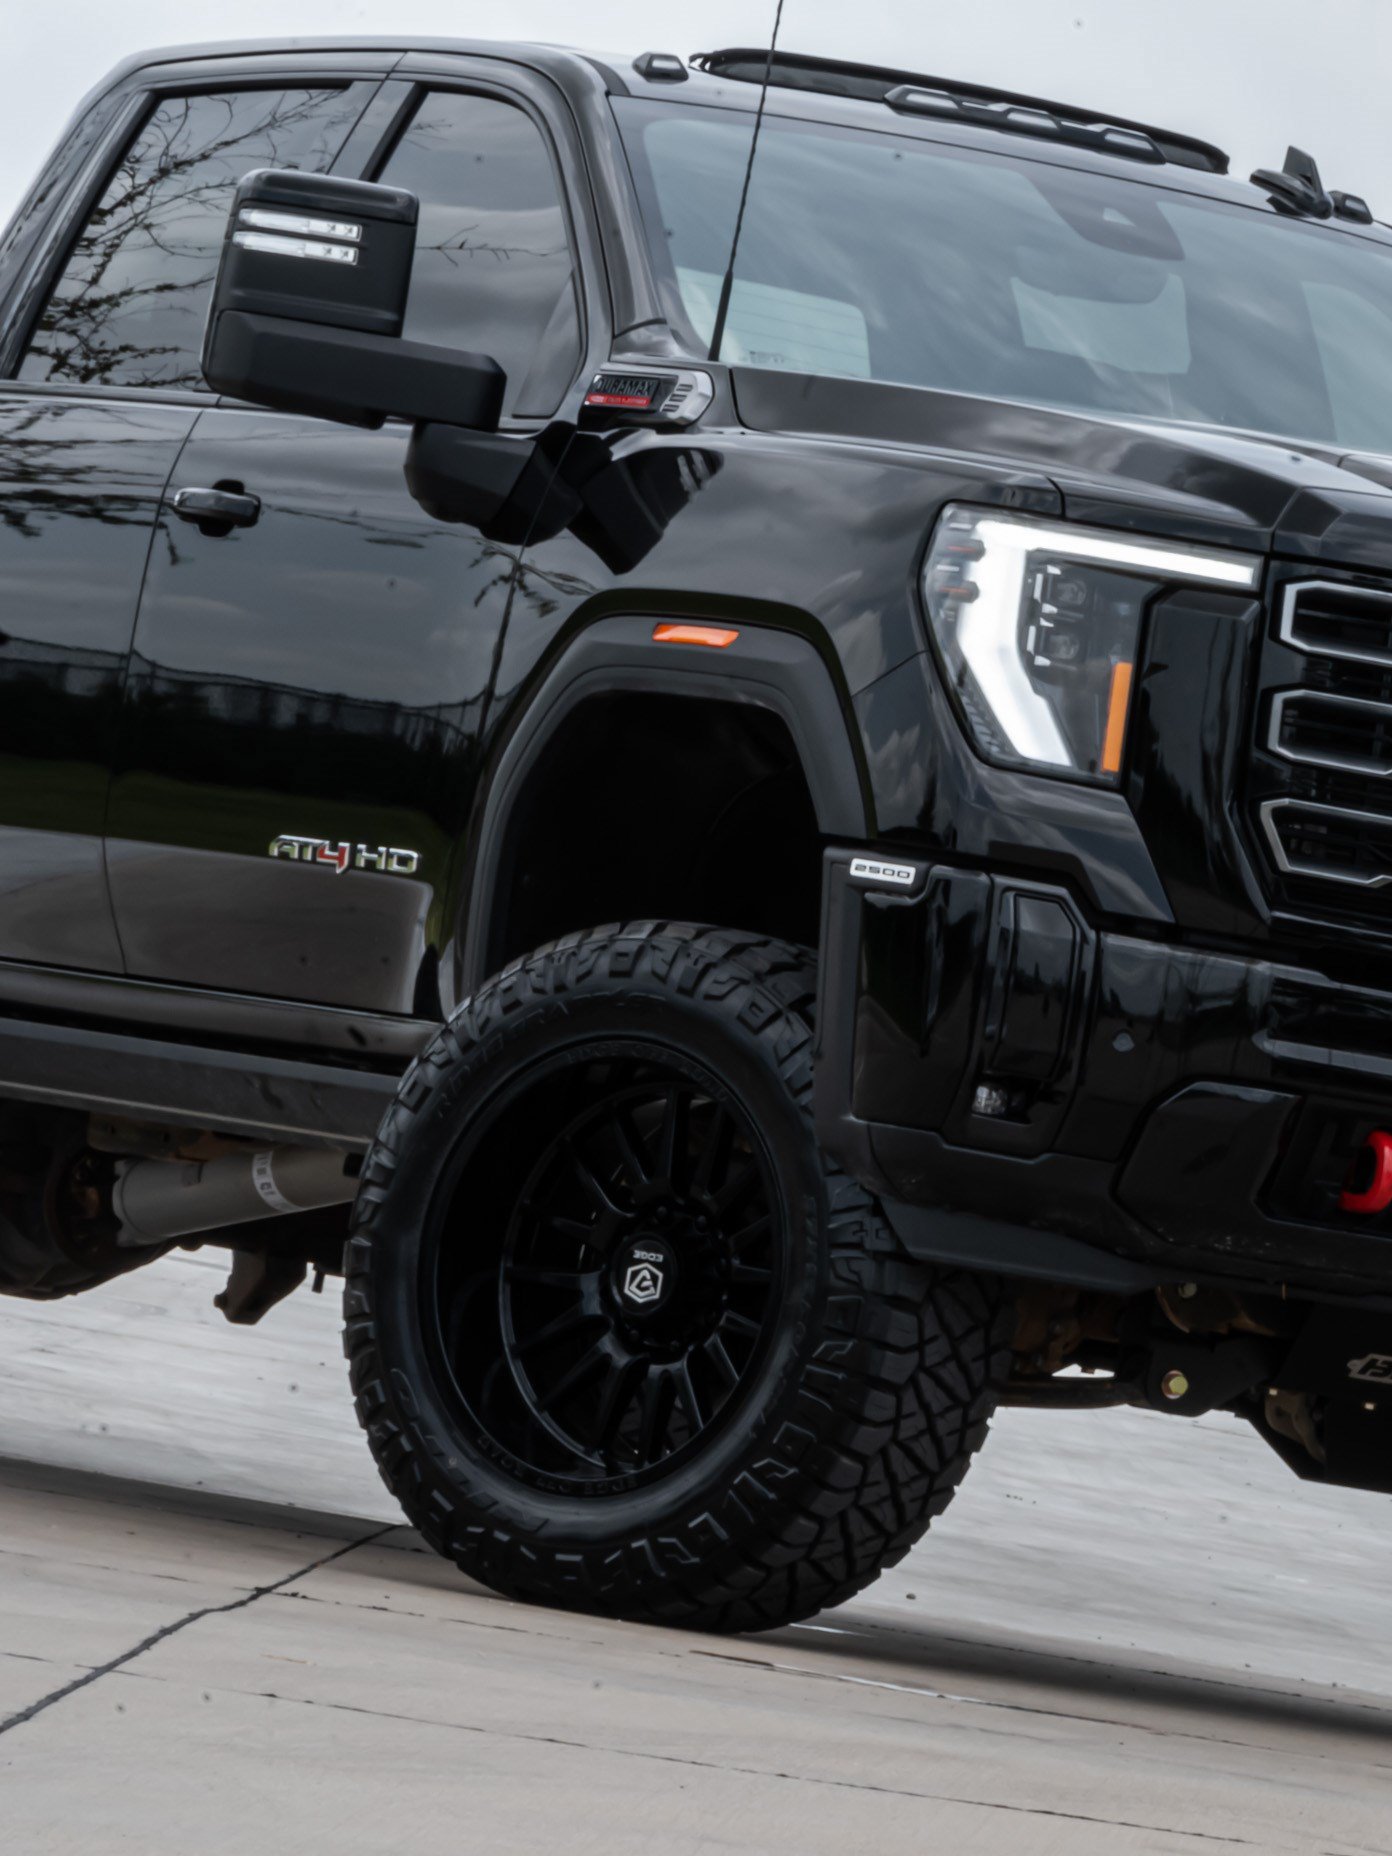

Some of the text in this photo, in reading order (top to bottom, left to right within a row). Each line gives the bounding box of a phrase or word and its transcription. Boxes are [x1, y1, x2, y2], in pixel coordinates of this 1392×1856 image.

[269, 834, 419, 874] AT4 HD
[854, 863, 911, 879] 2500
[633, 1249, 664, 1262] EDGE
